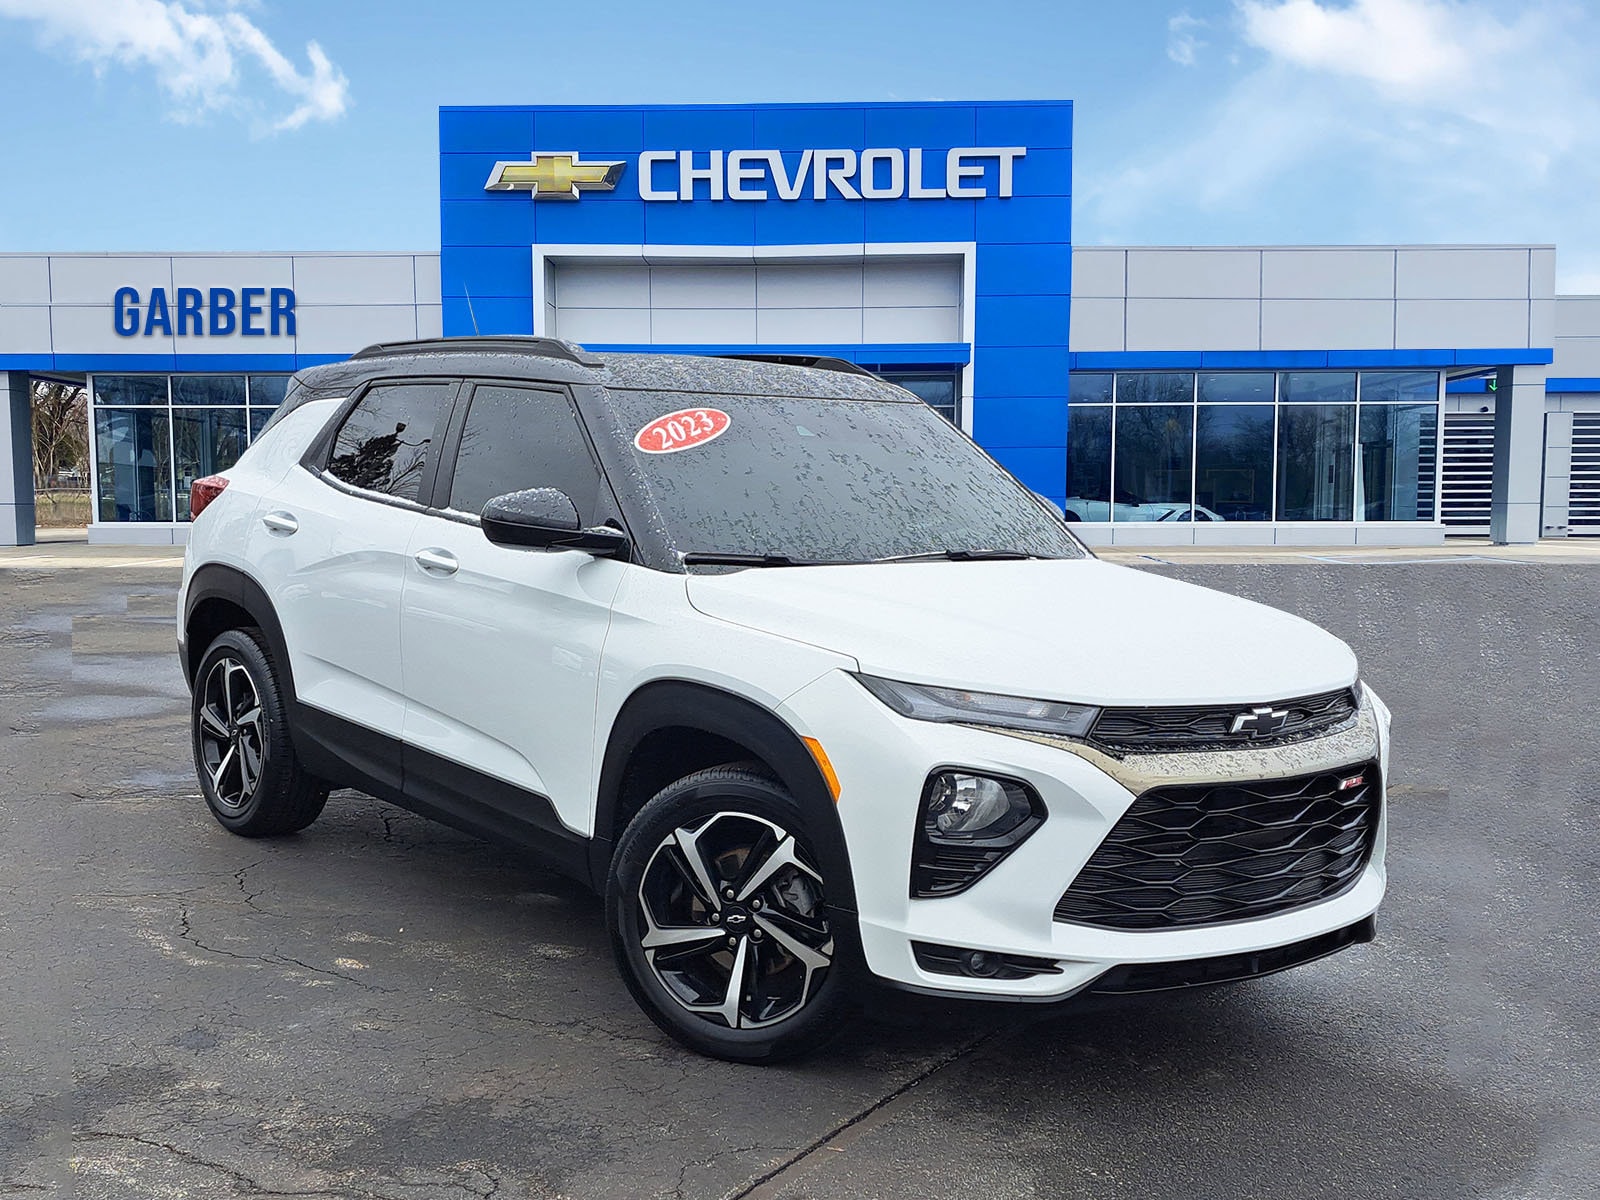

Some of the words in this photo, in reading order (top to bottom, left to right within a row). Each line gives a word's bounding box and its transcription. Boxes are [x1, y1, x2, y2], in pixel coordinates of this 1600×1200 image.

[638, 147, 1027, 201] CHEVROLET
[114, 286, 297, 337] GARBER
[652, 411, 714, 449] 2023
